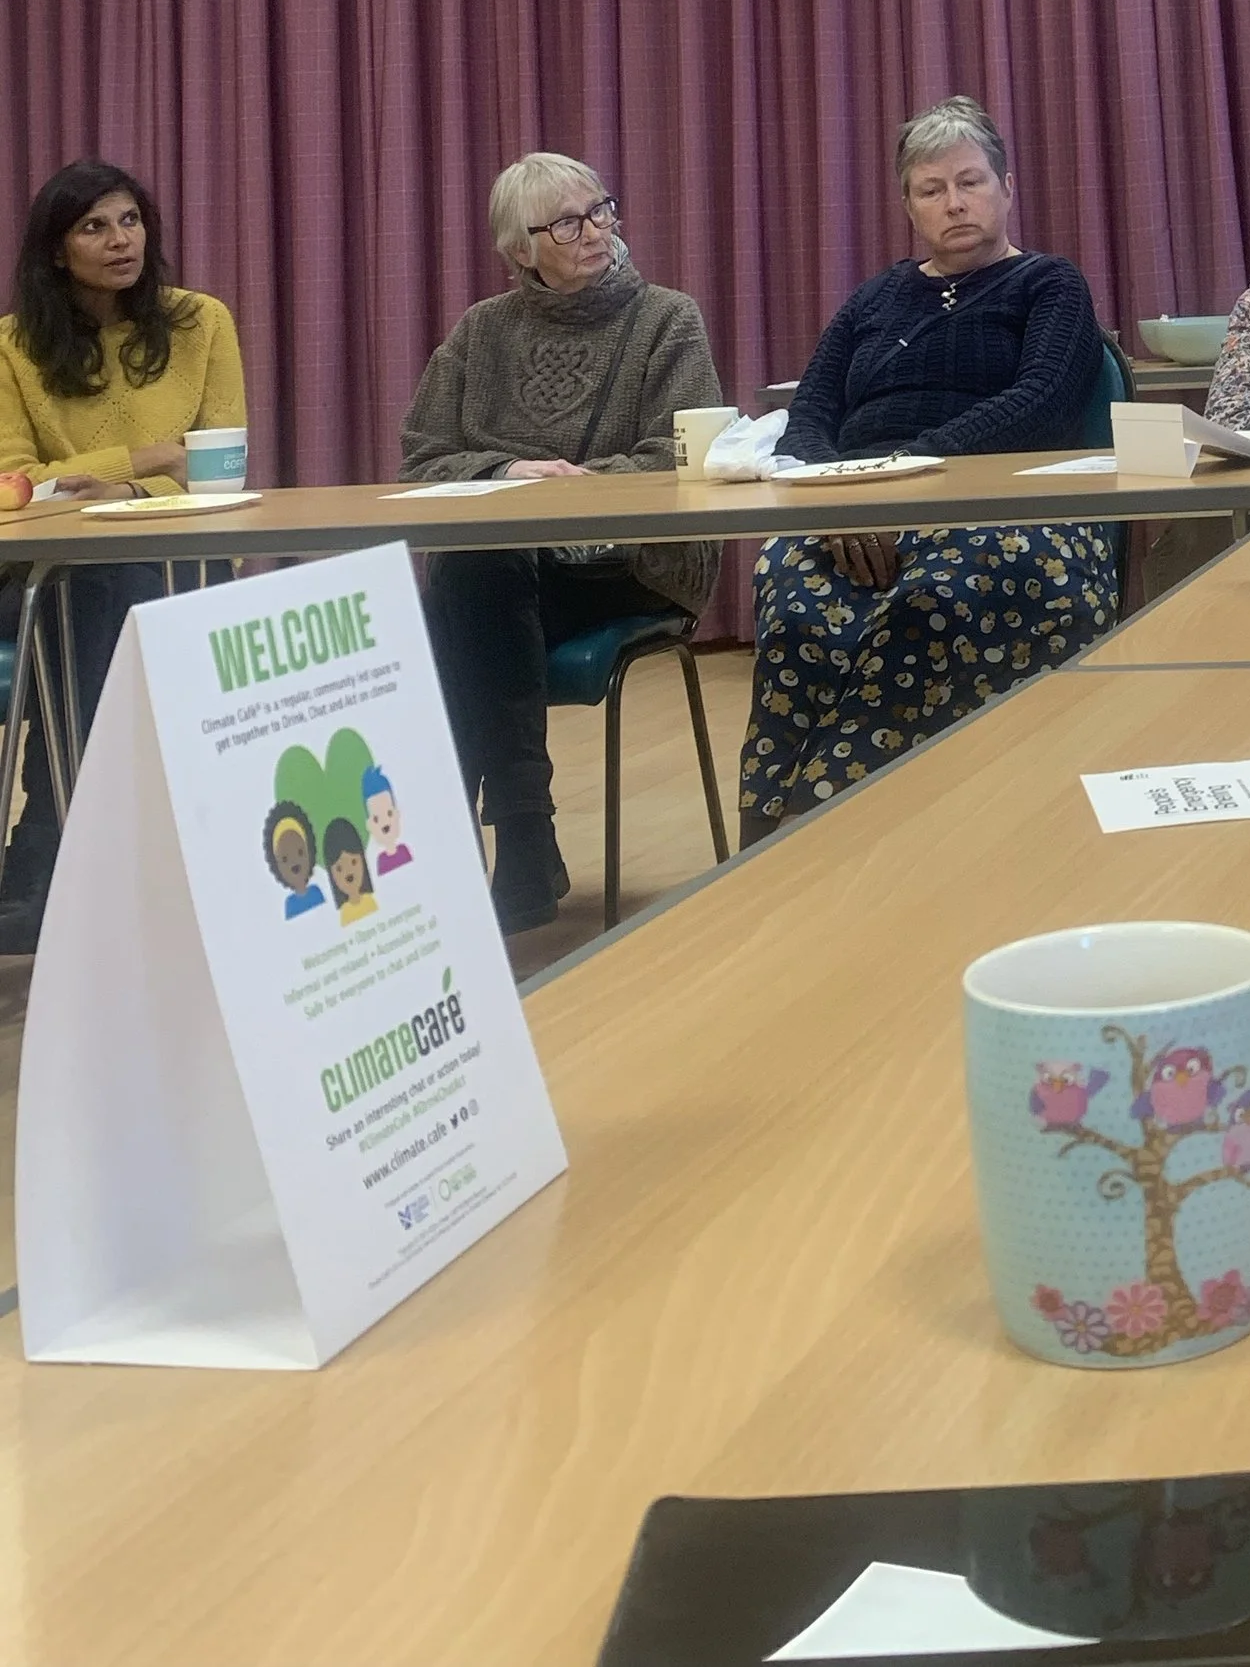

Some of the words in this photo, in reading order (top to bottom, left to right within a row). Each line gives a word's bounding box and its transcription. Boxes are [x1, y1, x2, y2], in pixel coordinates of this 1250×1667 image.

[208, 591, 376, 694] WELCOME
[201, 715, 235, 734] Climate
[232, 725, 269, 745] together
[326, 1128, 351, 1151] Share
[354, 1120, 364, 1134] an
[365, 1091, 409, 1125] interesting
[409, 1079, 426, 1097] chat
[427, 1074, 434, 1085] or
[437, 1058, 459, 1079] action
[363, 1122, 447, 1189] www.climate.cafe
